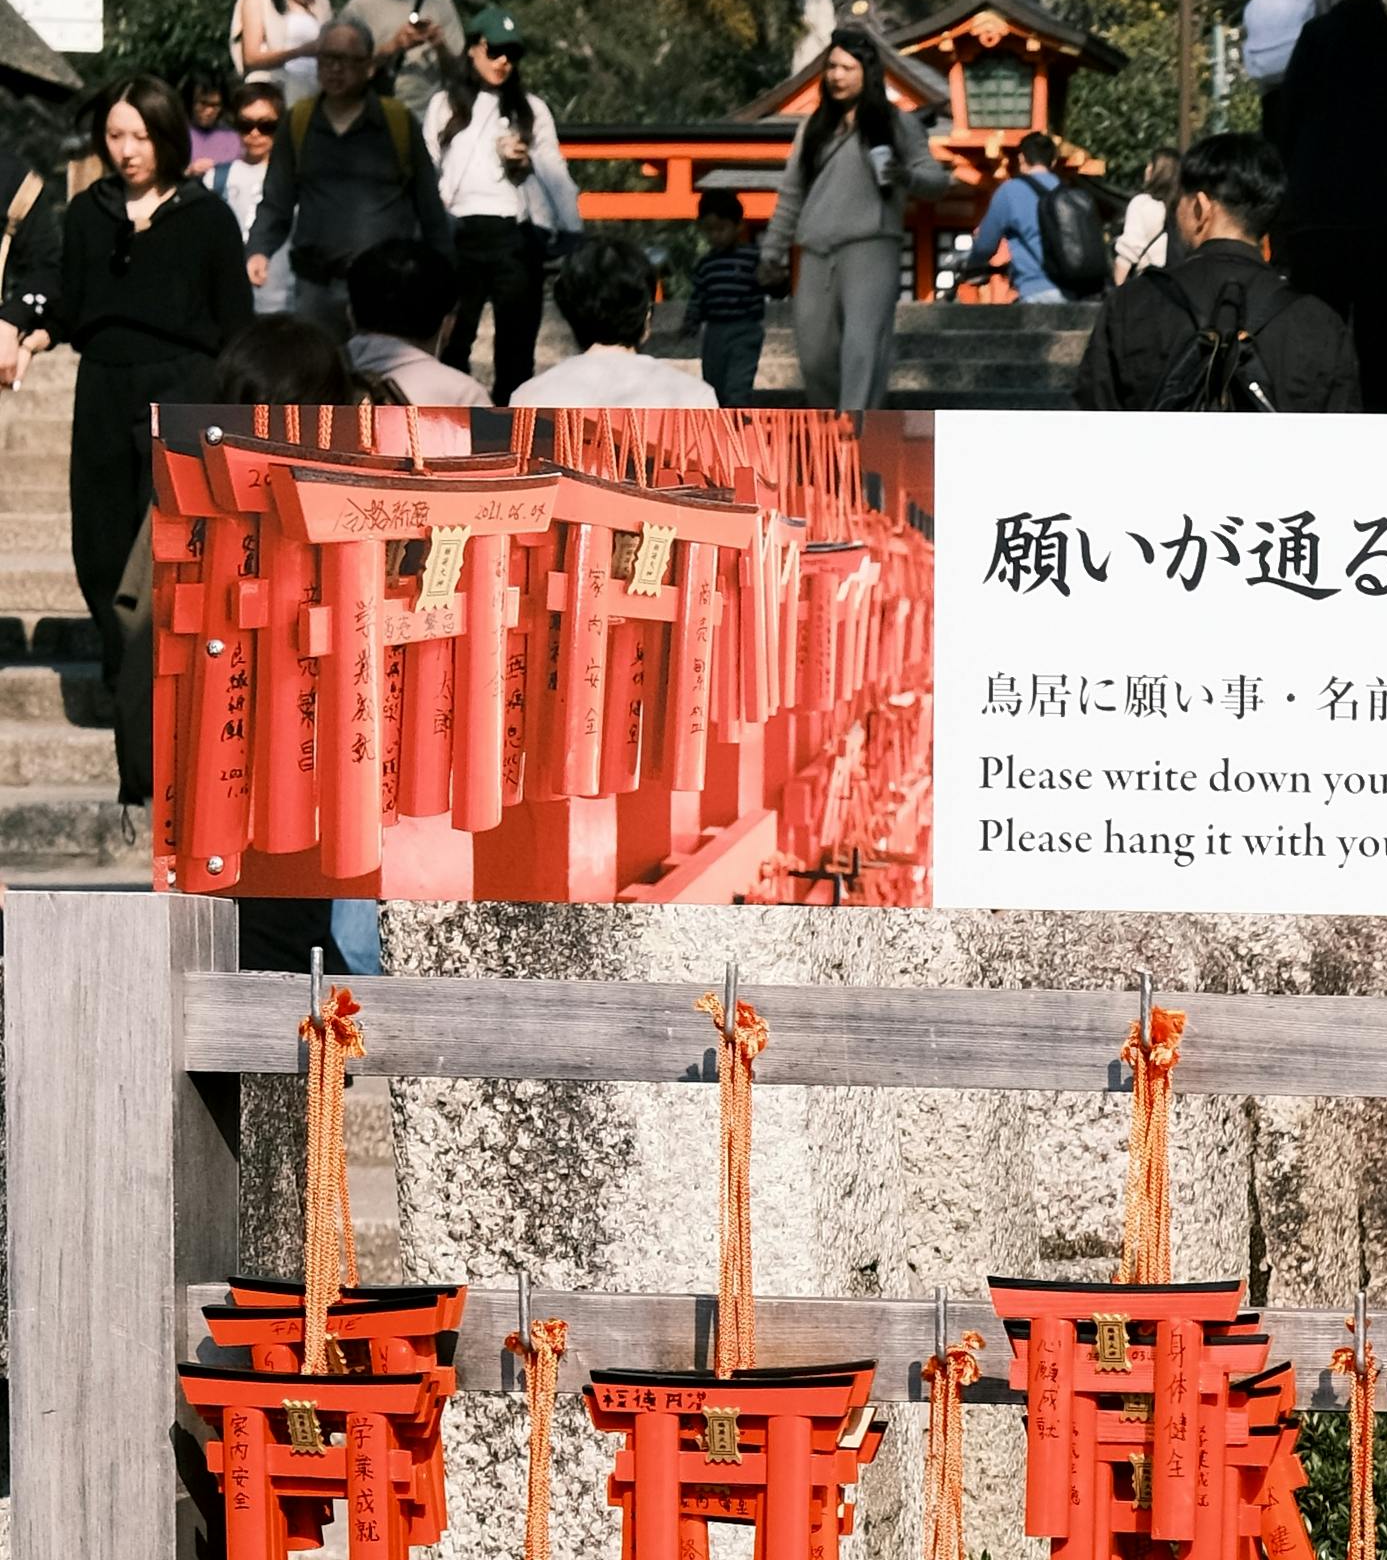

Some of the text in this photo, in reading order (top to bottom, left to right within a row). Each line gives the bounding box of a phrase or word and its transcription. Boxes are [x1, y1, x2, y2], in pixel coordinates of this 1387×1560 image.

[980, 755, 1092, 789] Please
[1103, 761, 1197, 791] write
[1210, 758, 1310, 793] down
[979, 818, 1092, 853] Please
[1104, 819, 1195, 867] hang
[1206, 824, 1232, 855] it
[1242, 822, 1326, 856] with
[1035, 1335, 1063, 1441] 心願成就
[1163, 1328, 1191, 1481] 身体健全
[229, 1412, 251, 1511] 家内安全
[350, 1417, 381, 1543] 学業成就
